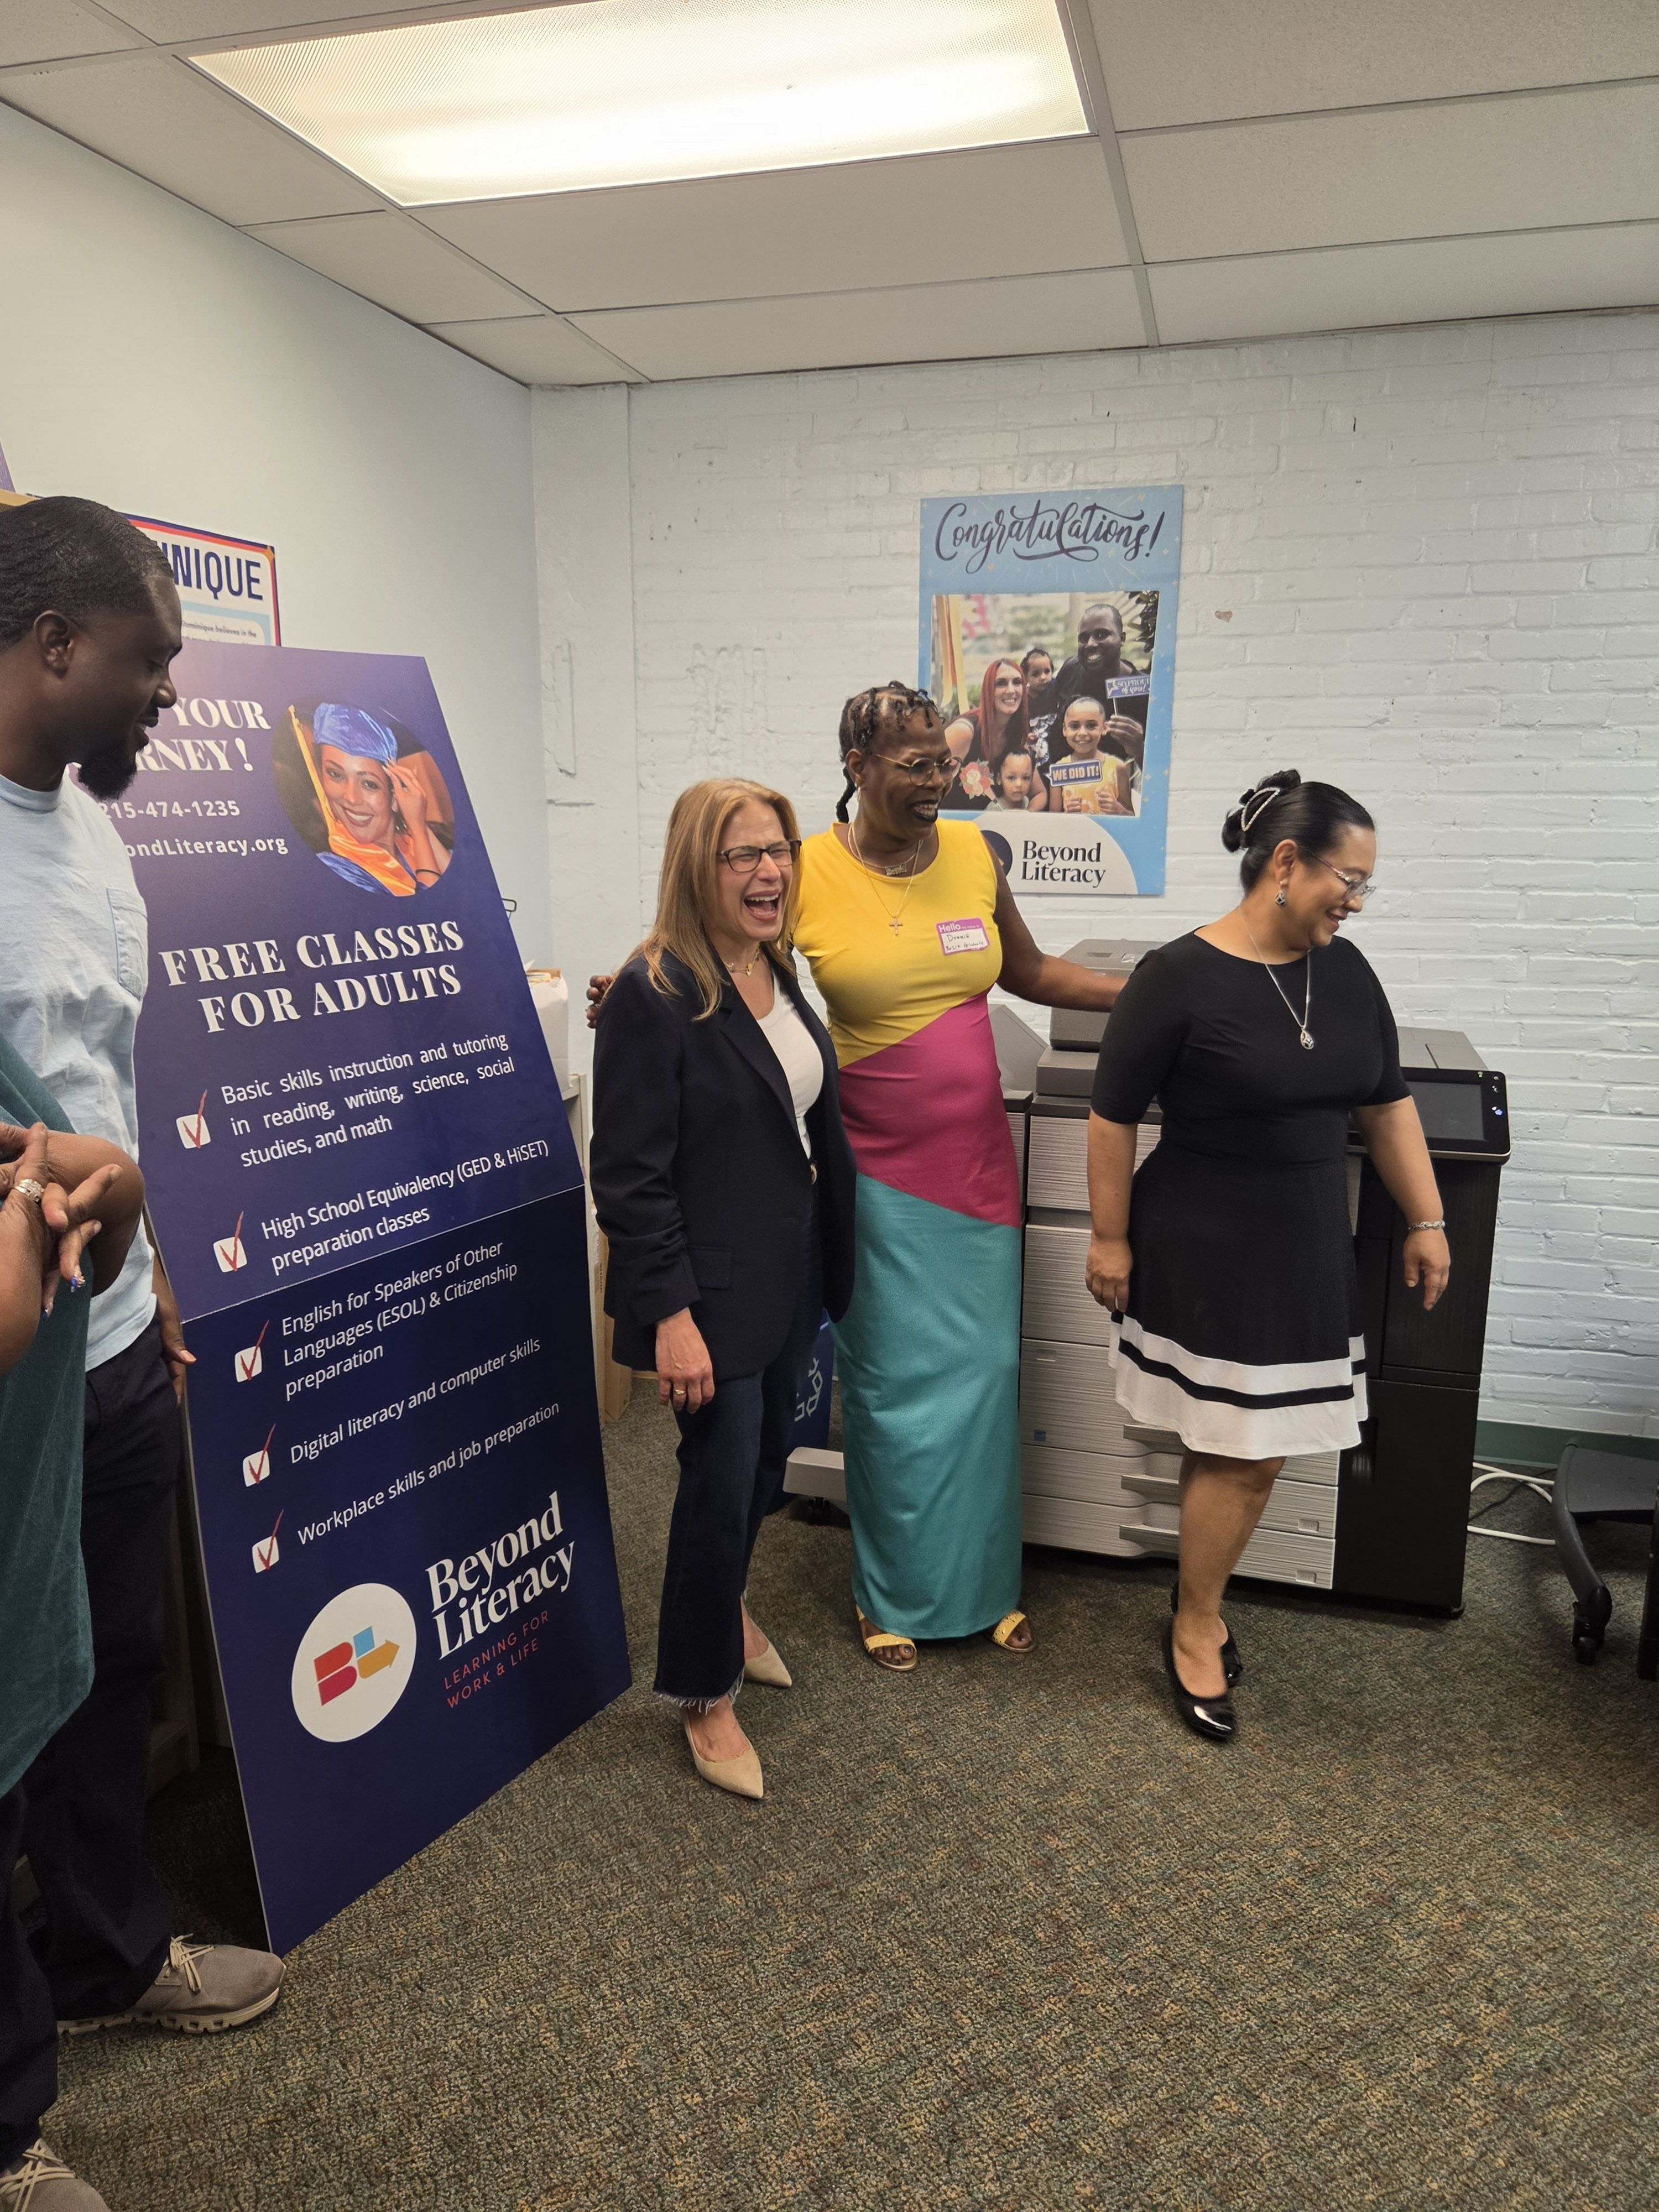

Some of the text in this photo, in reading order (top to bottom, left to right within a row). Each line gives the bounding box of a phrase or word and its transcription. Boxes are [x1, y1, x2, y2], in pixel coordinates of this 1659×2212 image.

[935, 499, 1165, 574] Congratulations!
[171, 697, 272, 729] YOUR
[1052, 765, 1099, 781] WE DID IT!
[98, 800, 241, 819] 215-474-1235
[1021, 861, 1106, 888] Literacy
[1022, 840, 1102, 866] Beyond
[159, 921, 463, 985] FREE CLASSES
[938, 922, 961, 933] Hello
[197, 964, 461, 1032] FOR ADULTS
[221, 1035, 508, 1104] Basic skills instruction and tutoring
[231, 1057, 514, 1135] in reading, writing, science, social
[241, 1115, 392, 1167] studies, and math
[262, 1140, 548, 1239] High School Equivalency (GED & HiSET)
[272, 1208, 430, 1276] preparation classes
[283, 1243, 503, 1335] English for Speakers of Other
[284, 1264, 517, 1366] Languages (ESOL) & Citizenship
[286, 1345, 383, 1401] preparation
[291, 1339, 540, 1463] Digital literacy and computer skills
[298, 1404, 559, 1545] Workplace skills and job preparation
[425, 1491, 563, 1613] Beyond
[433, 1541, 575, 1660] Literacy
[444, 1610, 547, 1690] LEARNING FOR
[447, 1638, 539, 1708] WORK & LIFE
